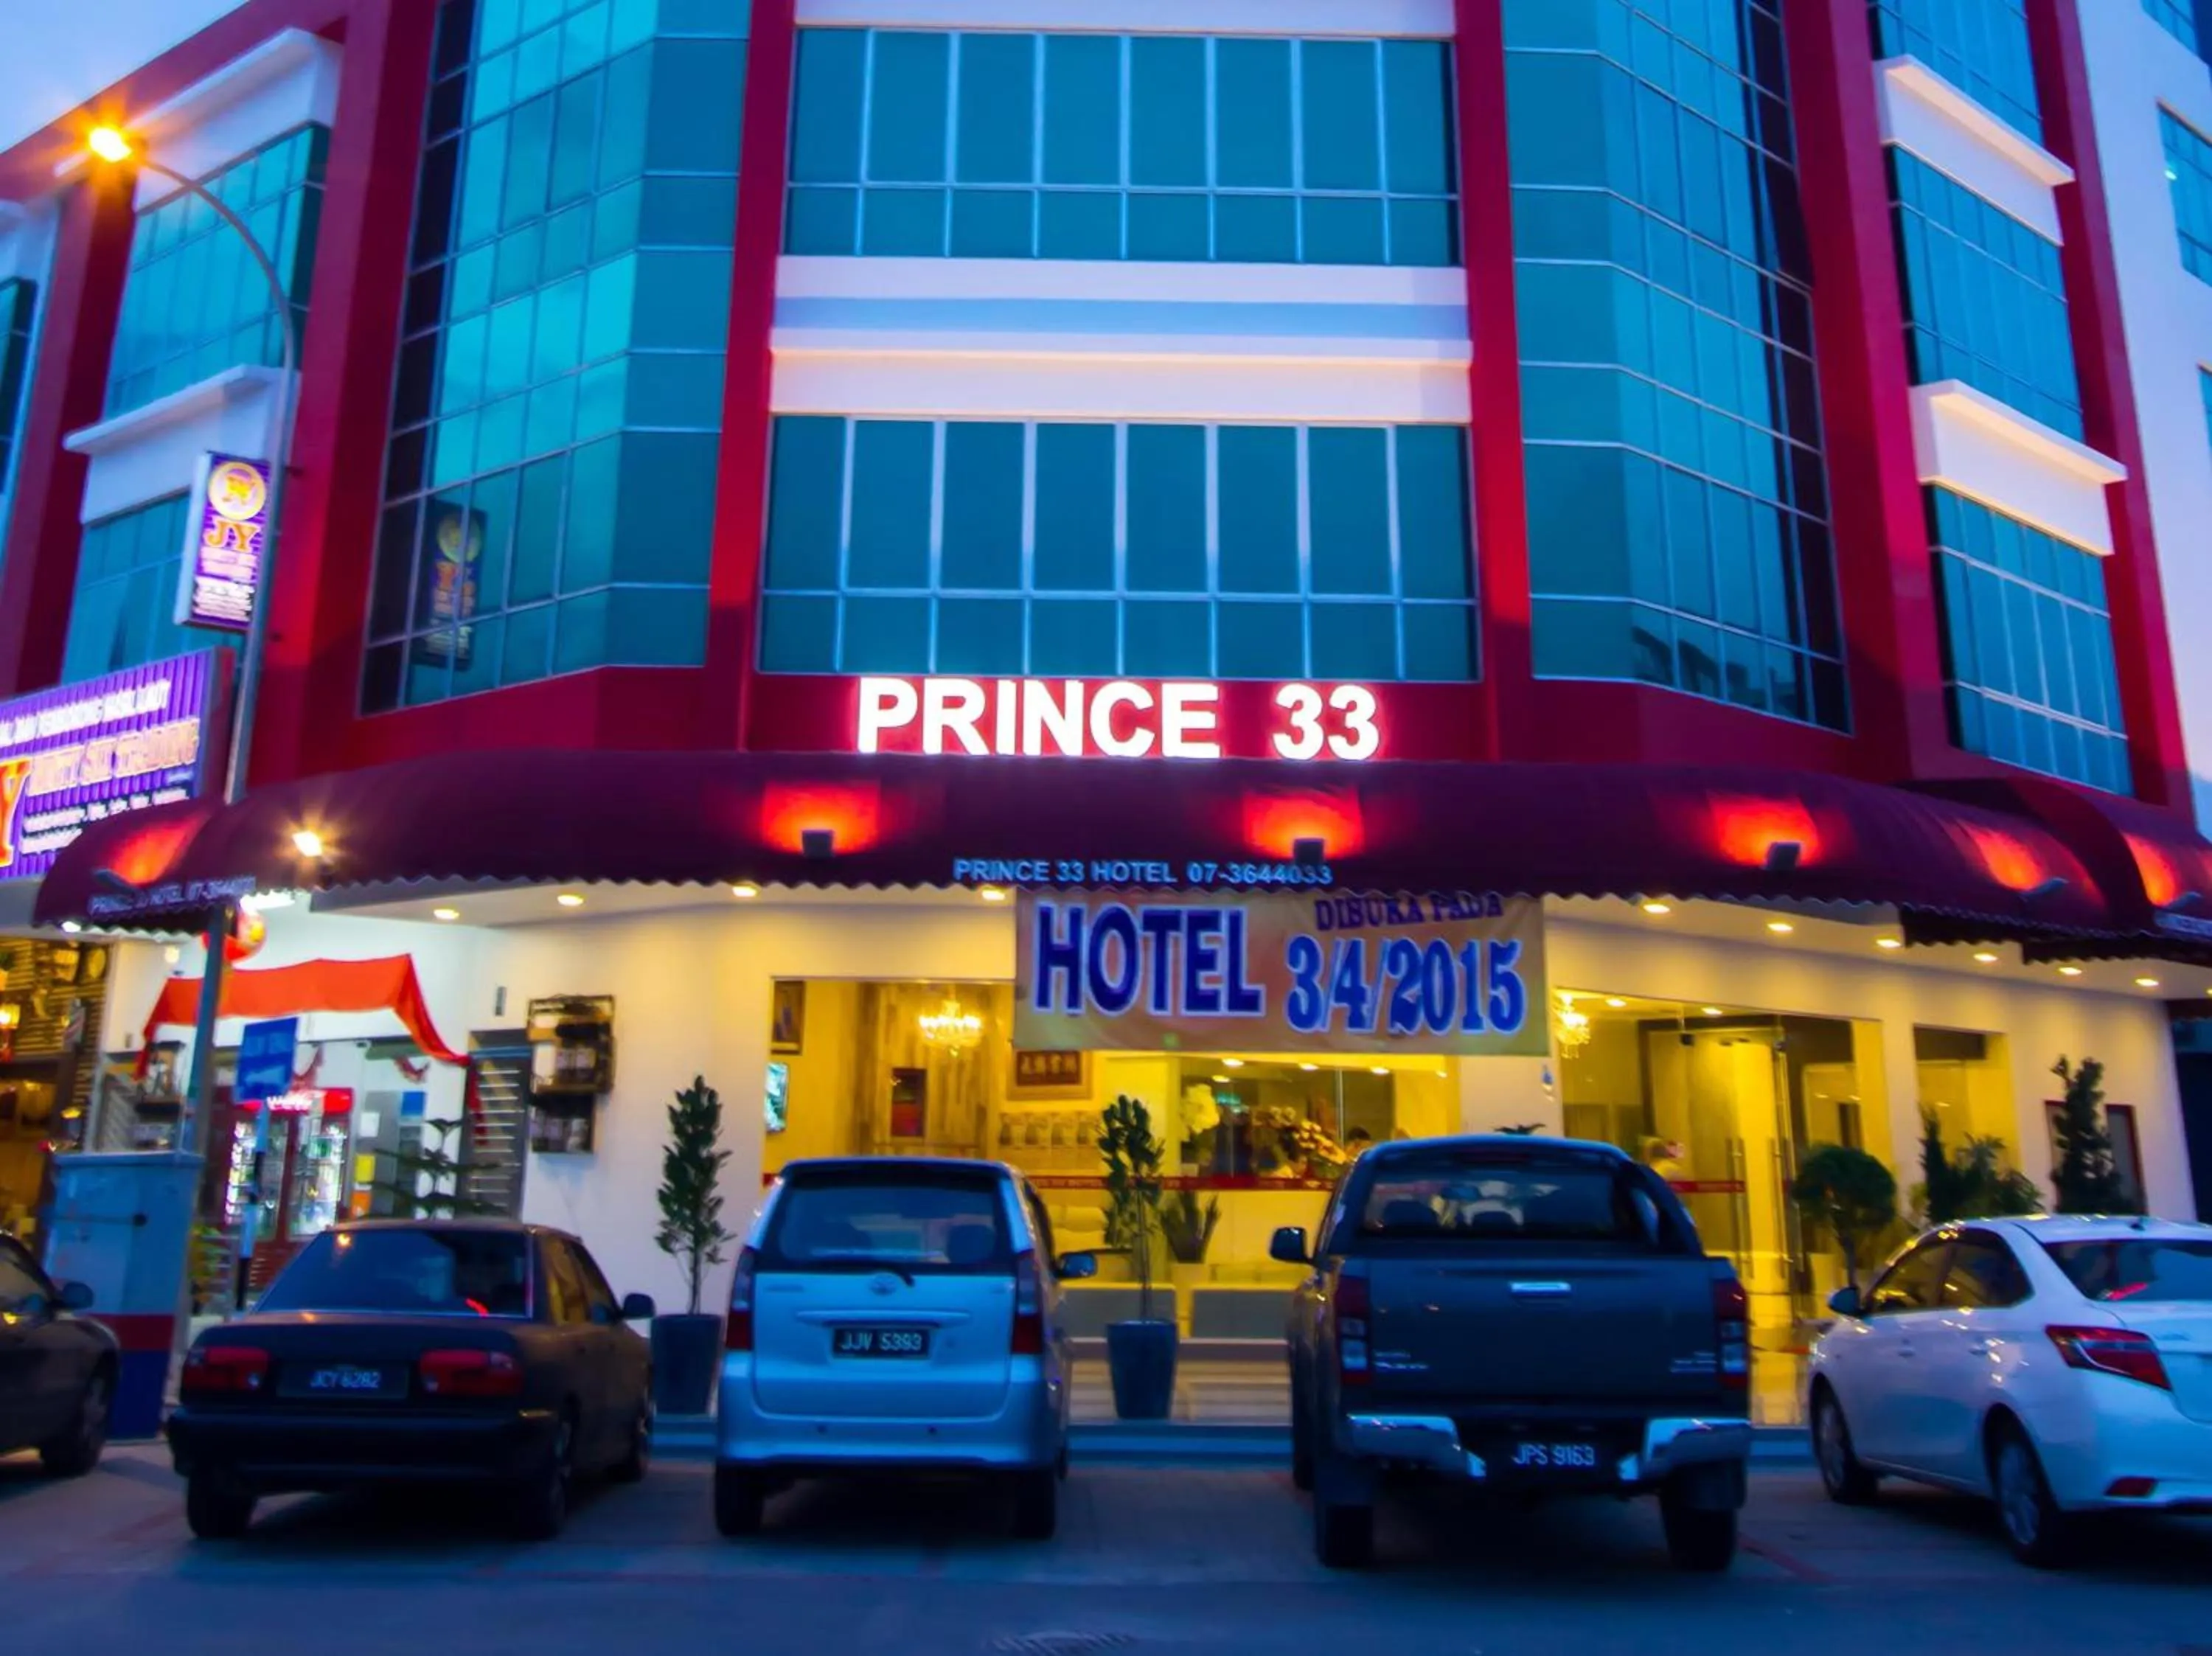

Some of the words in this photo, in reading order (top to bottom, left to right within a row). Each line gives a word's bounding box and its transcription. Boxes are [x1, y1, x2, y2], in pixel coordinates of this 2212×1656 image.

[204, 515, 260, 553] JY
[858, 677, 1221, 759] PRINCE
[1273, 683, 1380, 761] 33
[953, 859, 1050, 882] PRINCE
[1056, 861, 1085, 883] 33
[1091, 862, 1178, 883] HOTEL
[1186, 863, 1334, 885] 07-3644033
[1033, 901, 1265, 1016] HOTEL
[1284, 933, 1526, 1034] 3/4/2015
[1511, 1443, 1548, 1465] JPS
[1551, 1444, 1595, 1466] 9163
